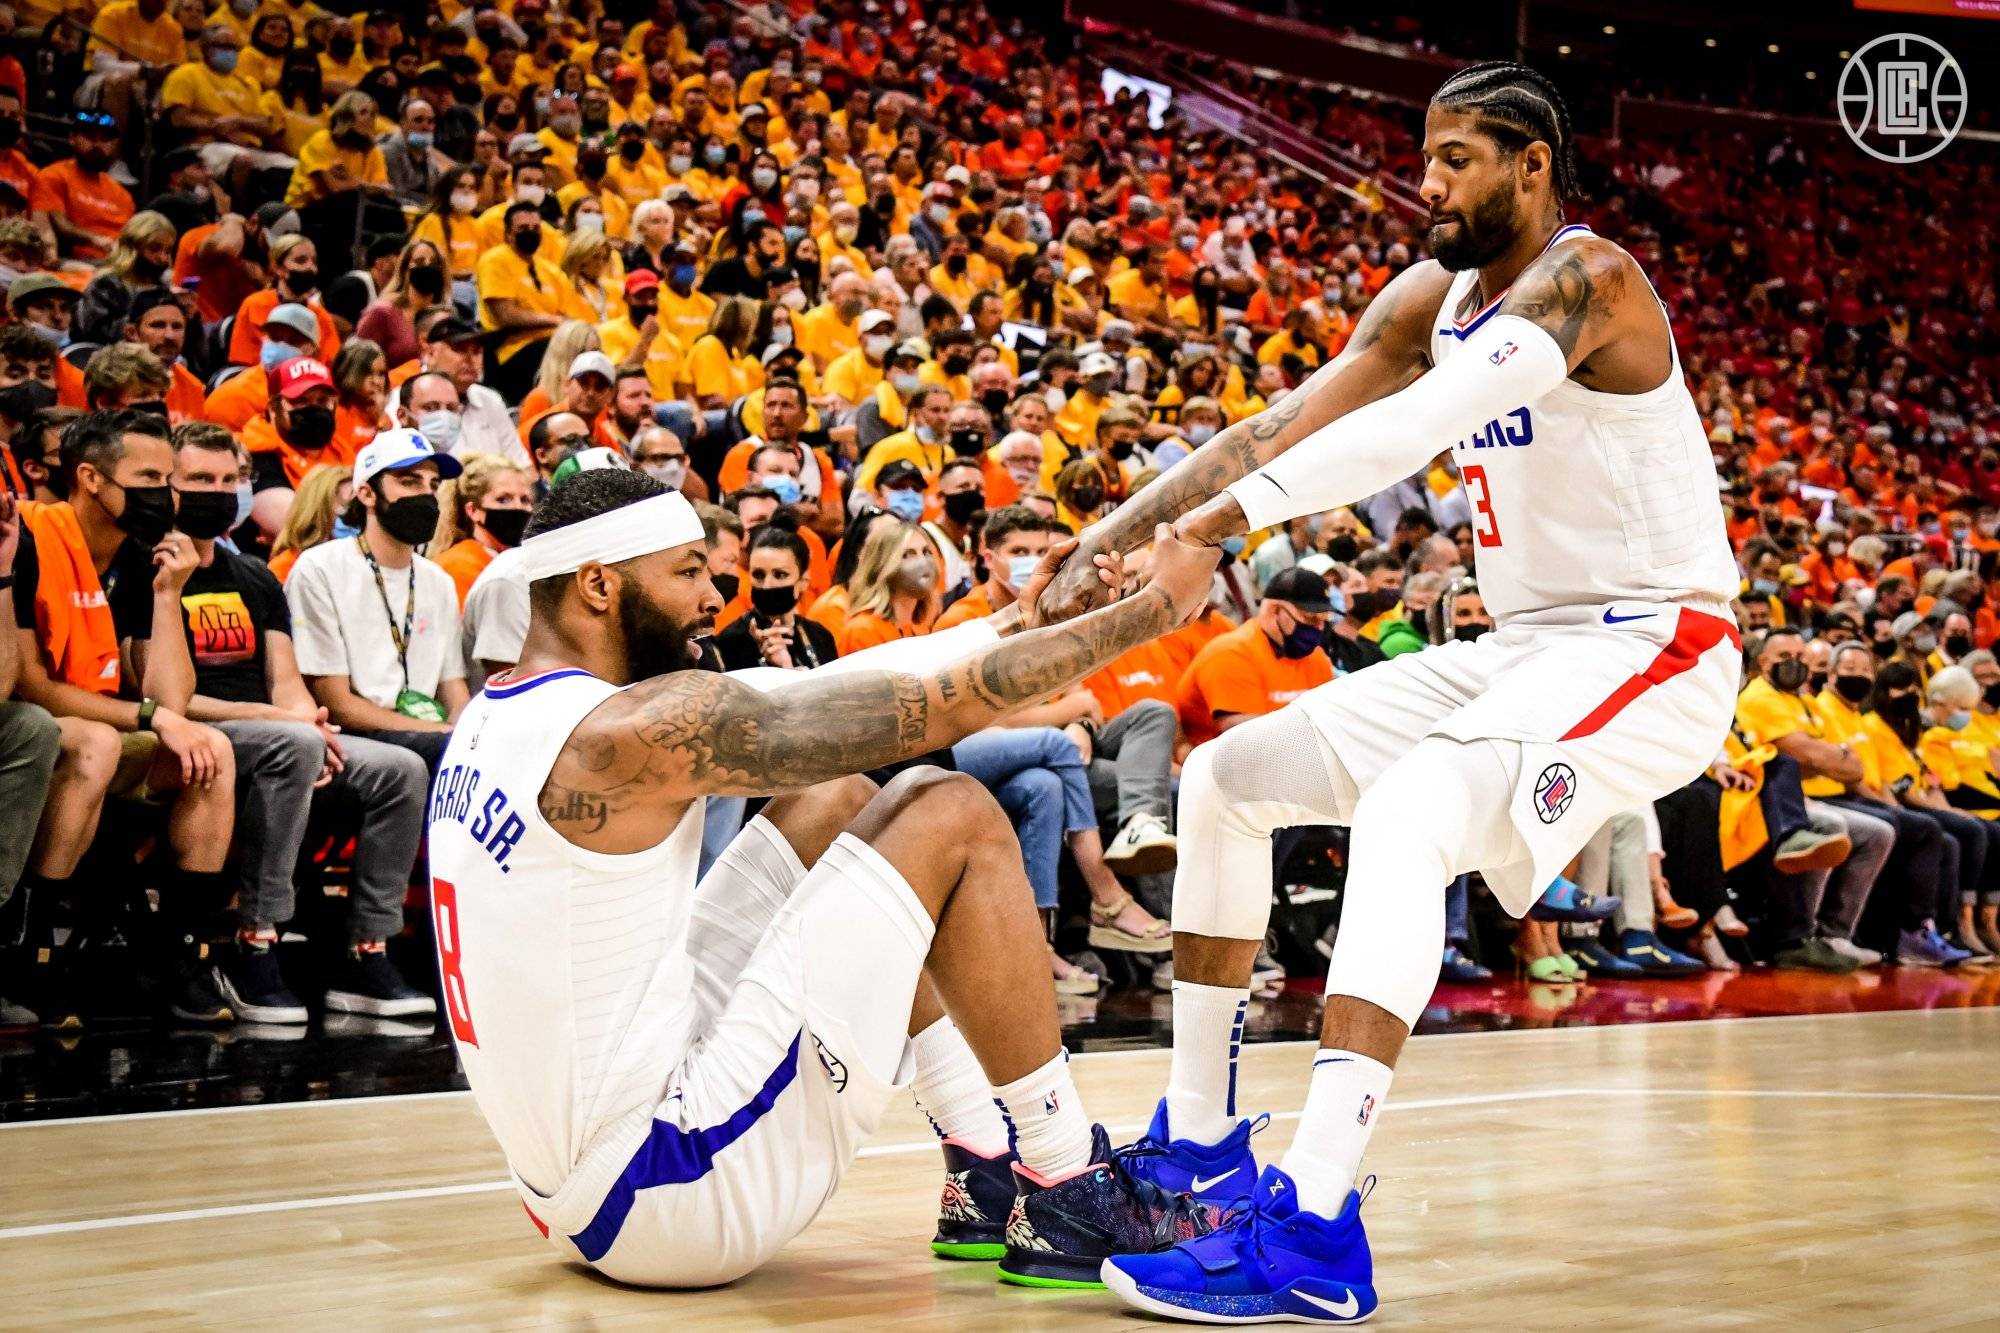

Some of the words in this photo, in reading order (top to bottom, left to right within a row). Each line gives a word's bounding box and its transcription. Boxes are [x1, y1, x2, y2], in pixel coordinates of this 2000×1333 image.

[288, 360, 329, 380] UTAH
[1456, 464, 1503, 548] 3
[430, 764, 481, 825] RRIS
[470, 787, 526, 874] SR.
[432, 876, 481, 1050] 8
